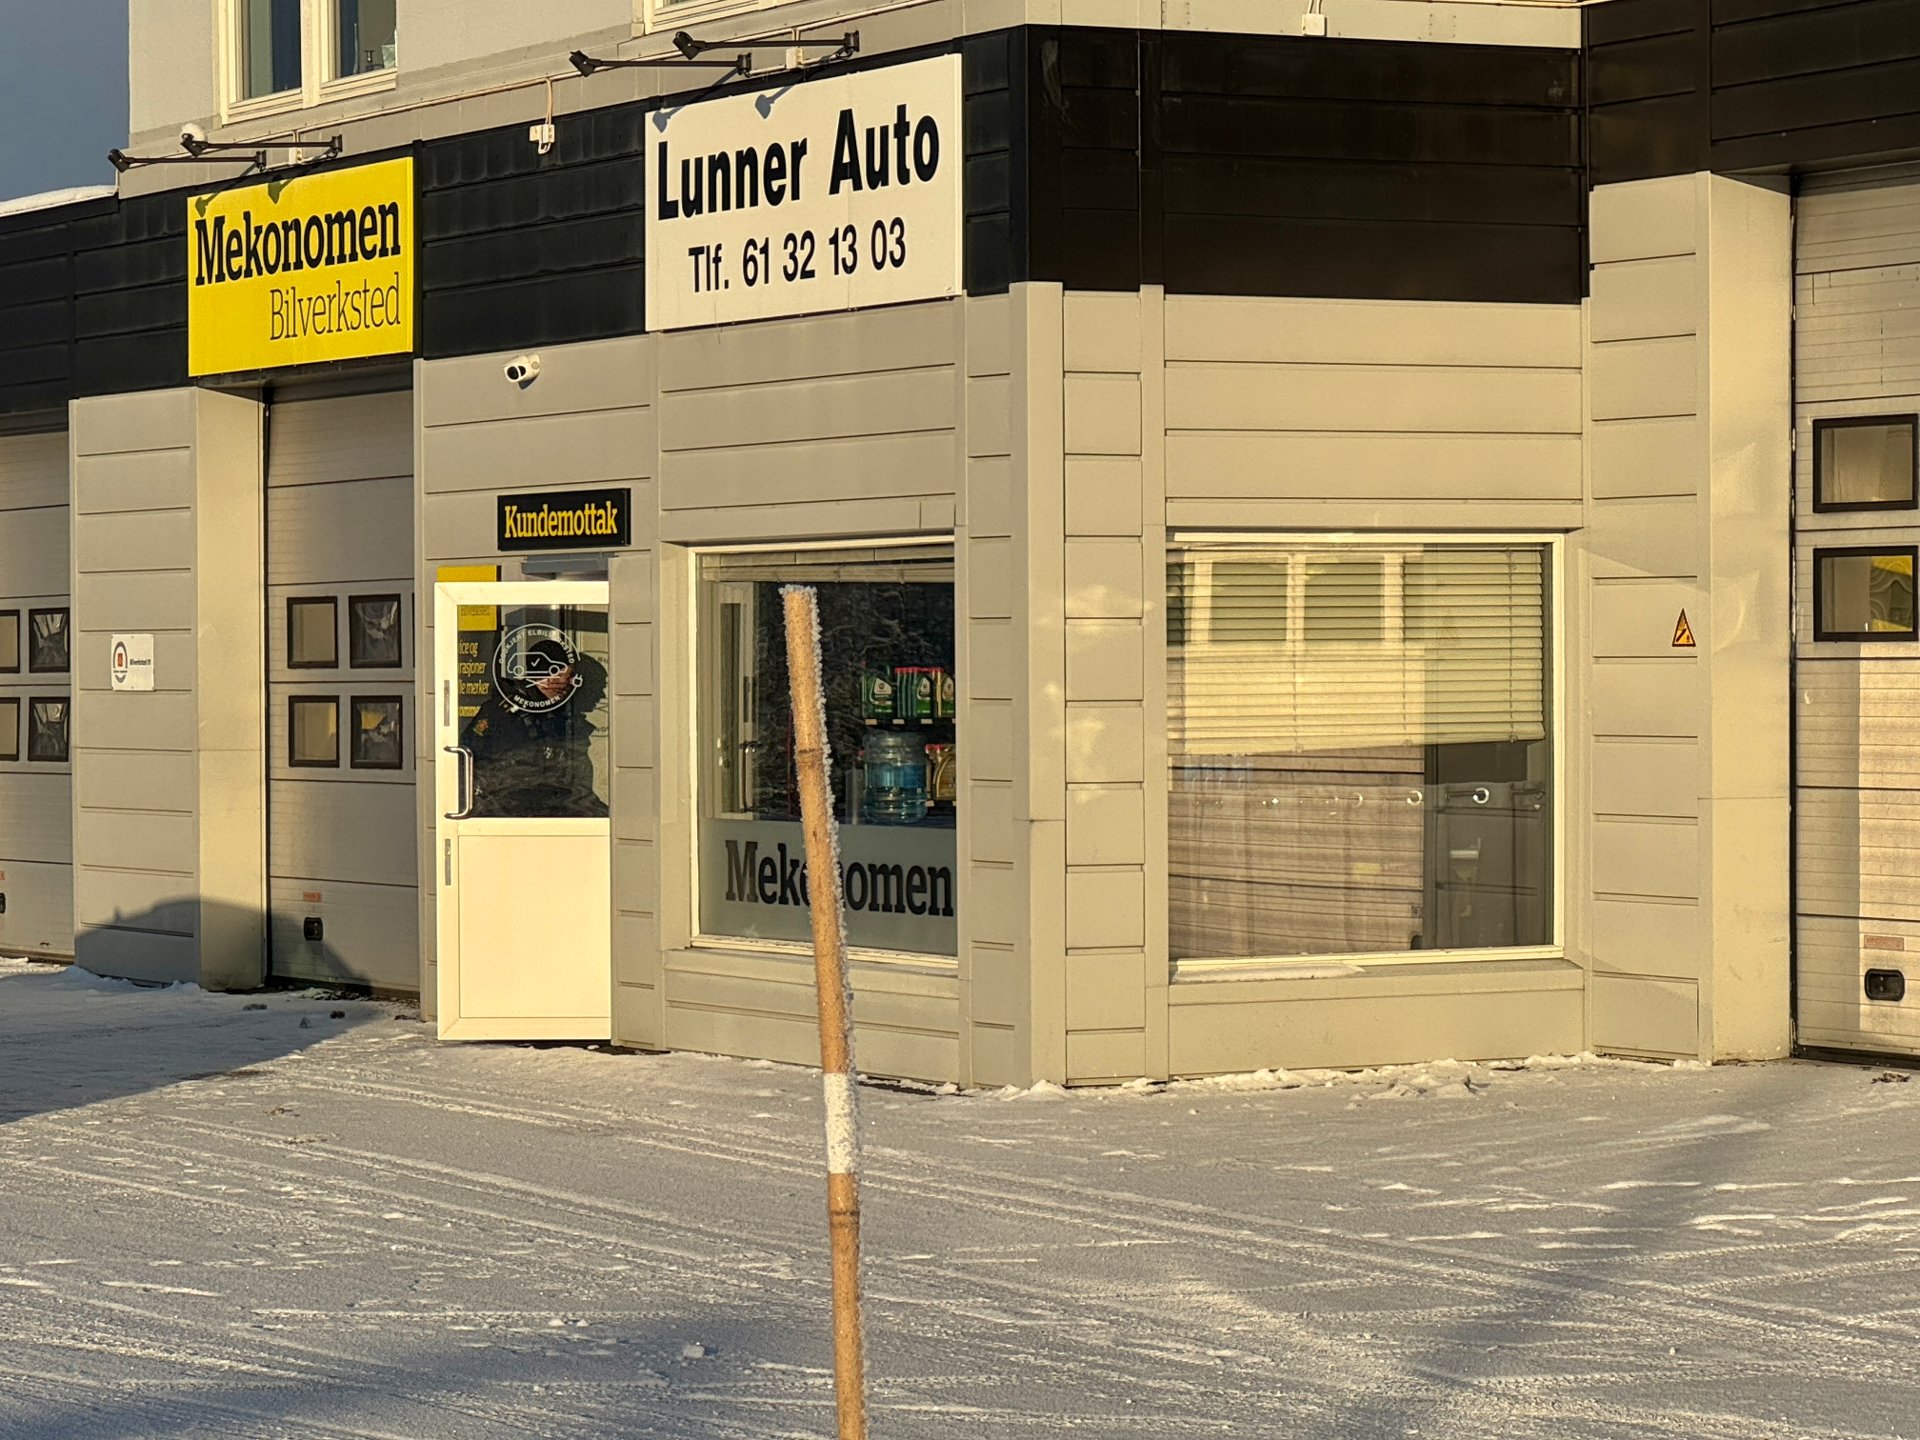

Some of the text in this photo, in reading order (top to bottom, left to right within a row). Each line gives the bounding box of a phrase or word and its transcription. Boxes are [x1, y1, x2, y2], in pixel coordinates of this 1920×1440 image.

[658, 103, 940, 221] Lunner Auto
[195, 201, 402, 286] Mekonomen
[688, 216, 906, 293] Tlf. 61 32 13 03
[269, 271, 401, 341] Bilverksted
[504, 500, 618, 539] Kundemottak
[725, 839, 954, 917] Mekomen
